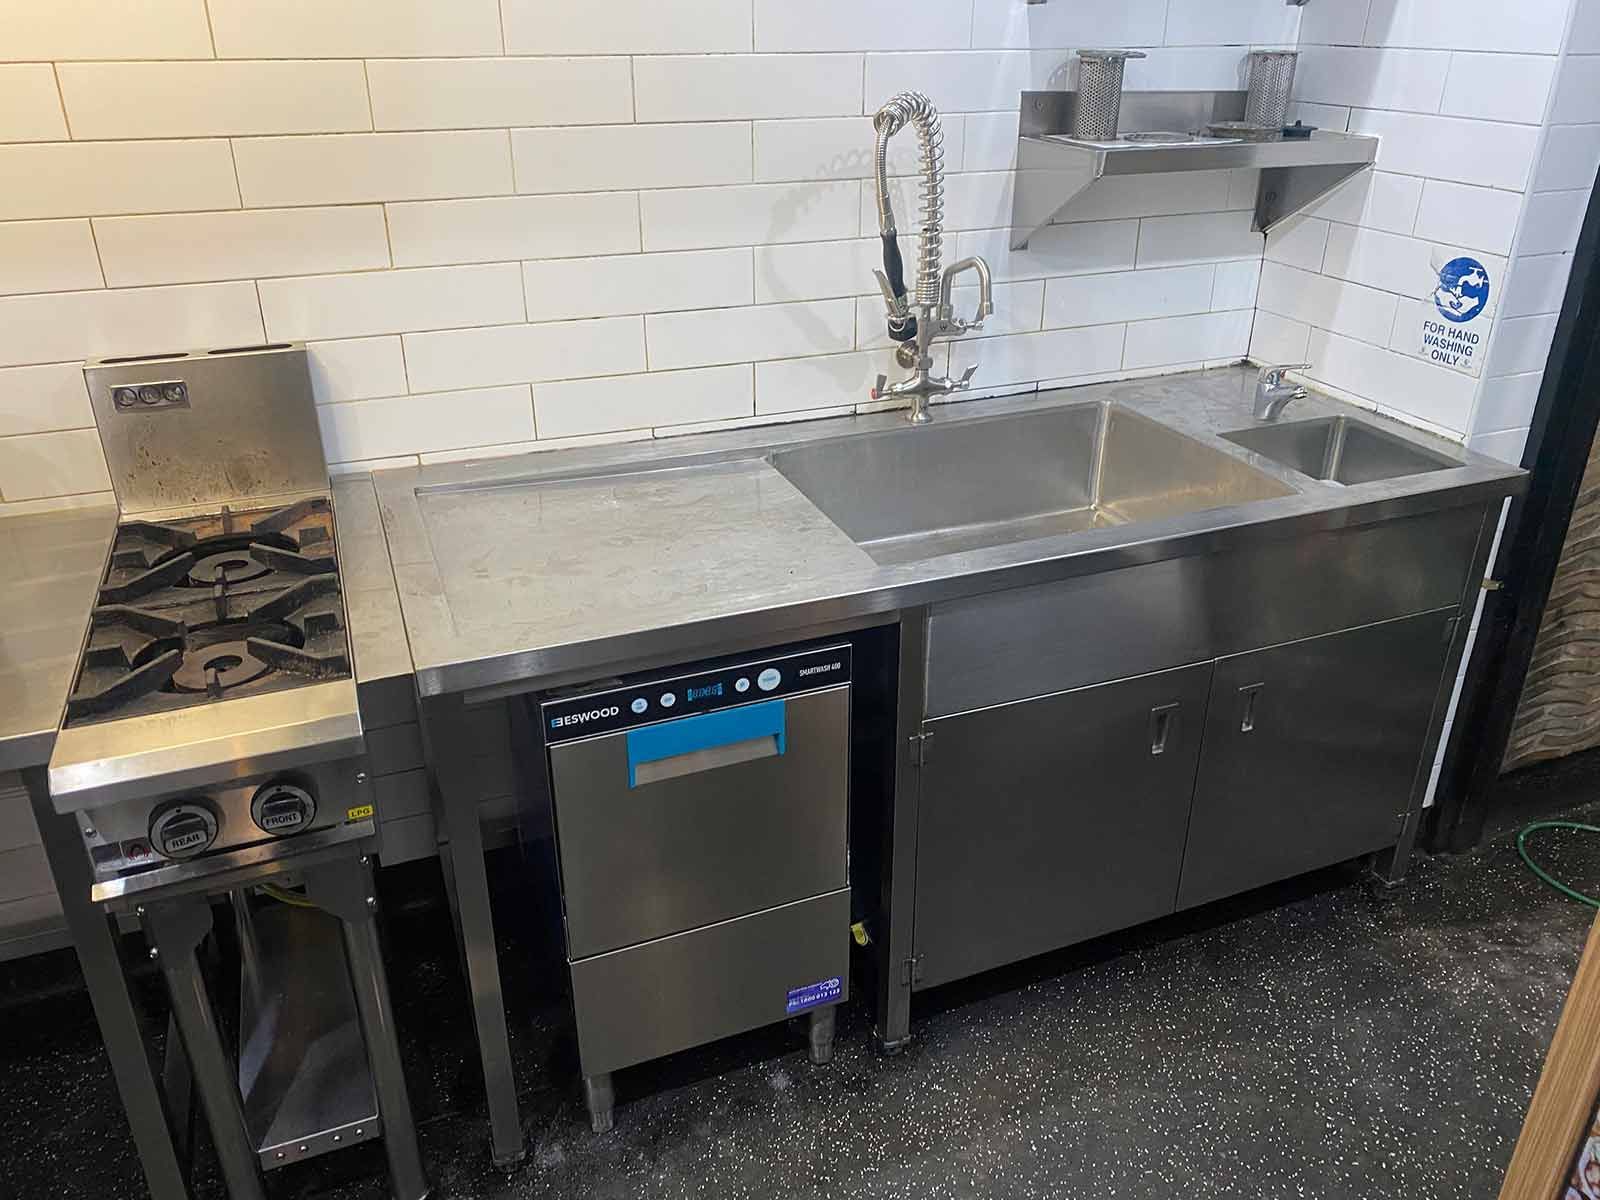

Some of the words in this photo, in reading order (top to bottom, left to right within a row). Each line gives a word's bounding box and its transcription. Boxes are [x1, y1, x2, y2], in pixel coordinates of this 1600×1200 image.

[1423, 321, 1446, 336] FOR
[1447, 327, 1480, 345] HAND
[1423, 333, 1473, 358] WASHING
[1431, 349, 1460, 366] ONLY
[799, 664, 831, 677] SMARTWASH
[265, 812, 298, 826] FRONT
[171, 832, 200, 849] REAR
